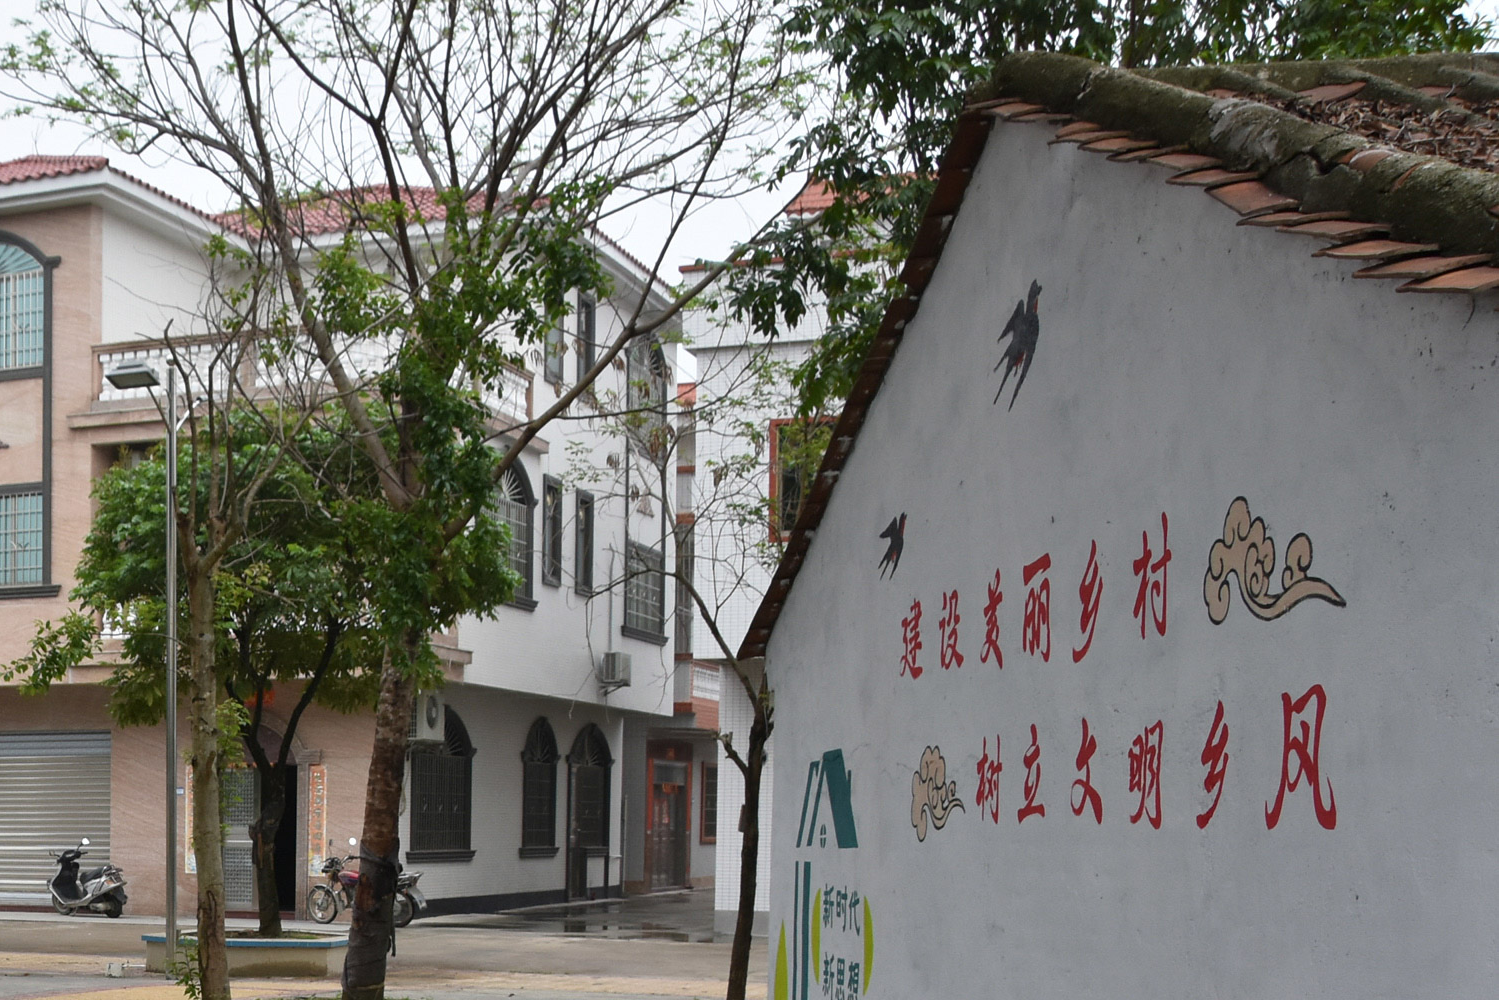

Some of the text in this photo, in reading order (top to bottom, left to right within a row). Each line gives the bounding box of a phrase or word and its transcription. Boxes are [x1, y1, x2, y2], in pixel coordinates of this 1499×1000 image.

[900, 511, 1173, 680] 建设美丽乡村
[974, 683, 1337, 830] 树立文明乡风
[822, 883, 861, 937] 新时代
